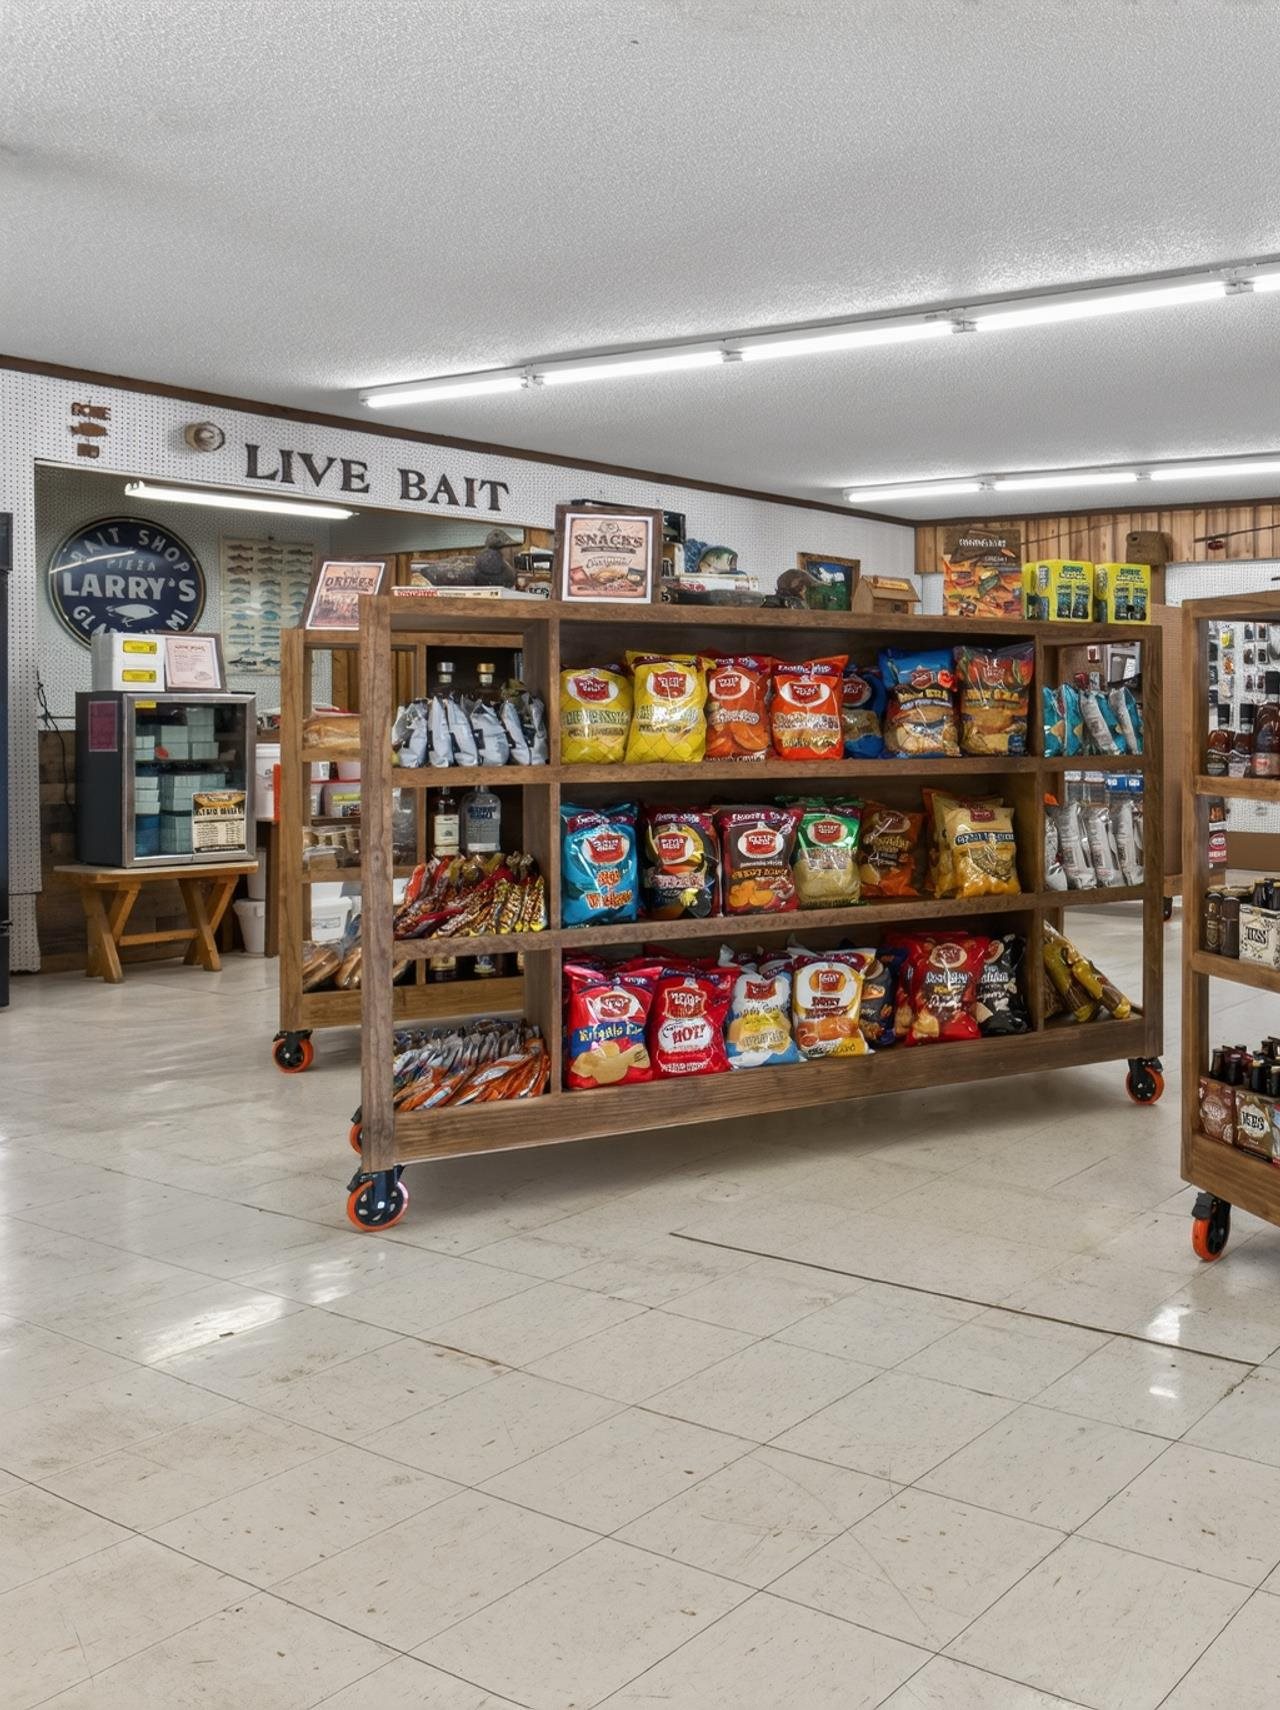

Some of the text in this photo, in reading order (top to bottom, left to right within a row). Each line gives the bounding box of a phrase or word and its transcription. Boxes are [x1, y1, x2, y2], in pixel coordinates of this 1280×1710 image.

[245, 443, 509, 512] LIVE BAIT
[69, 527, 190, 573] BAIT SHOP
[574, 533, 644, 549] SNACKS
[62, 572, 197, 602] LARRY'S
[165, 609, 189, 632] MI
